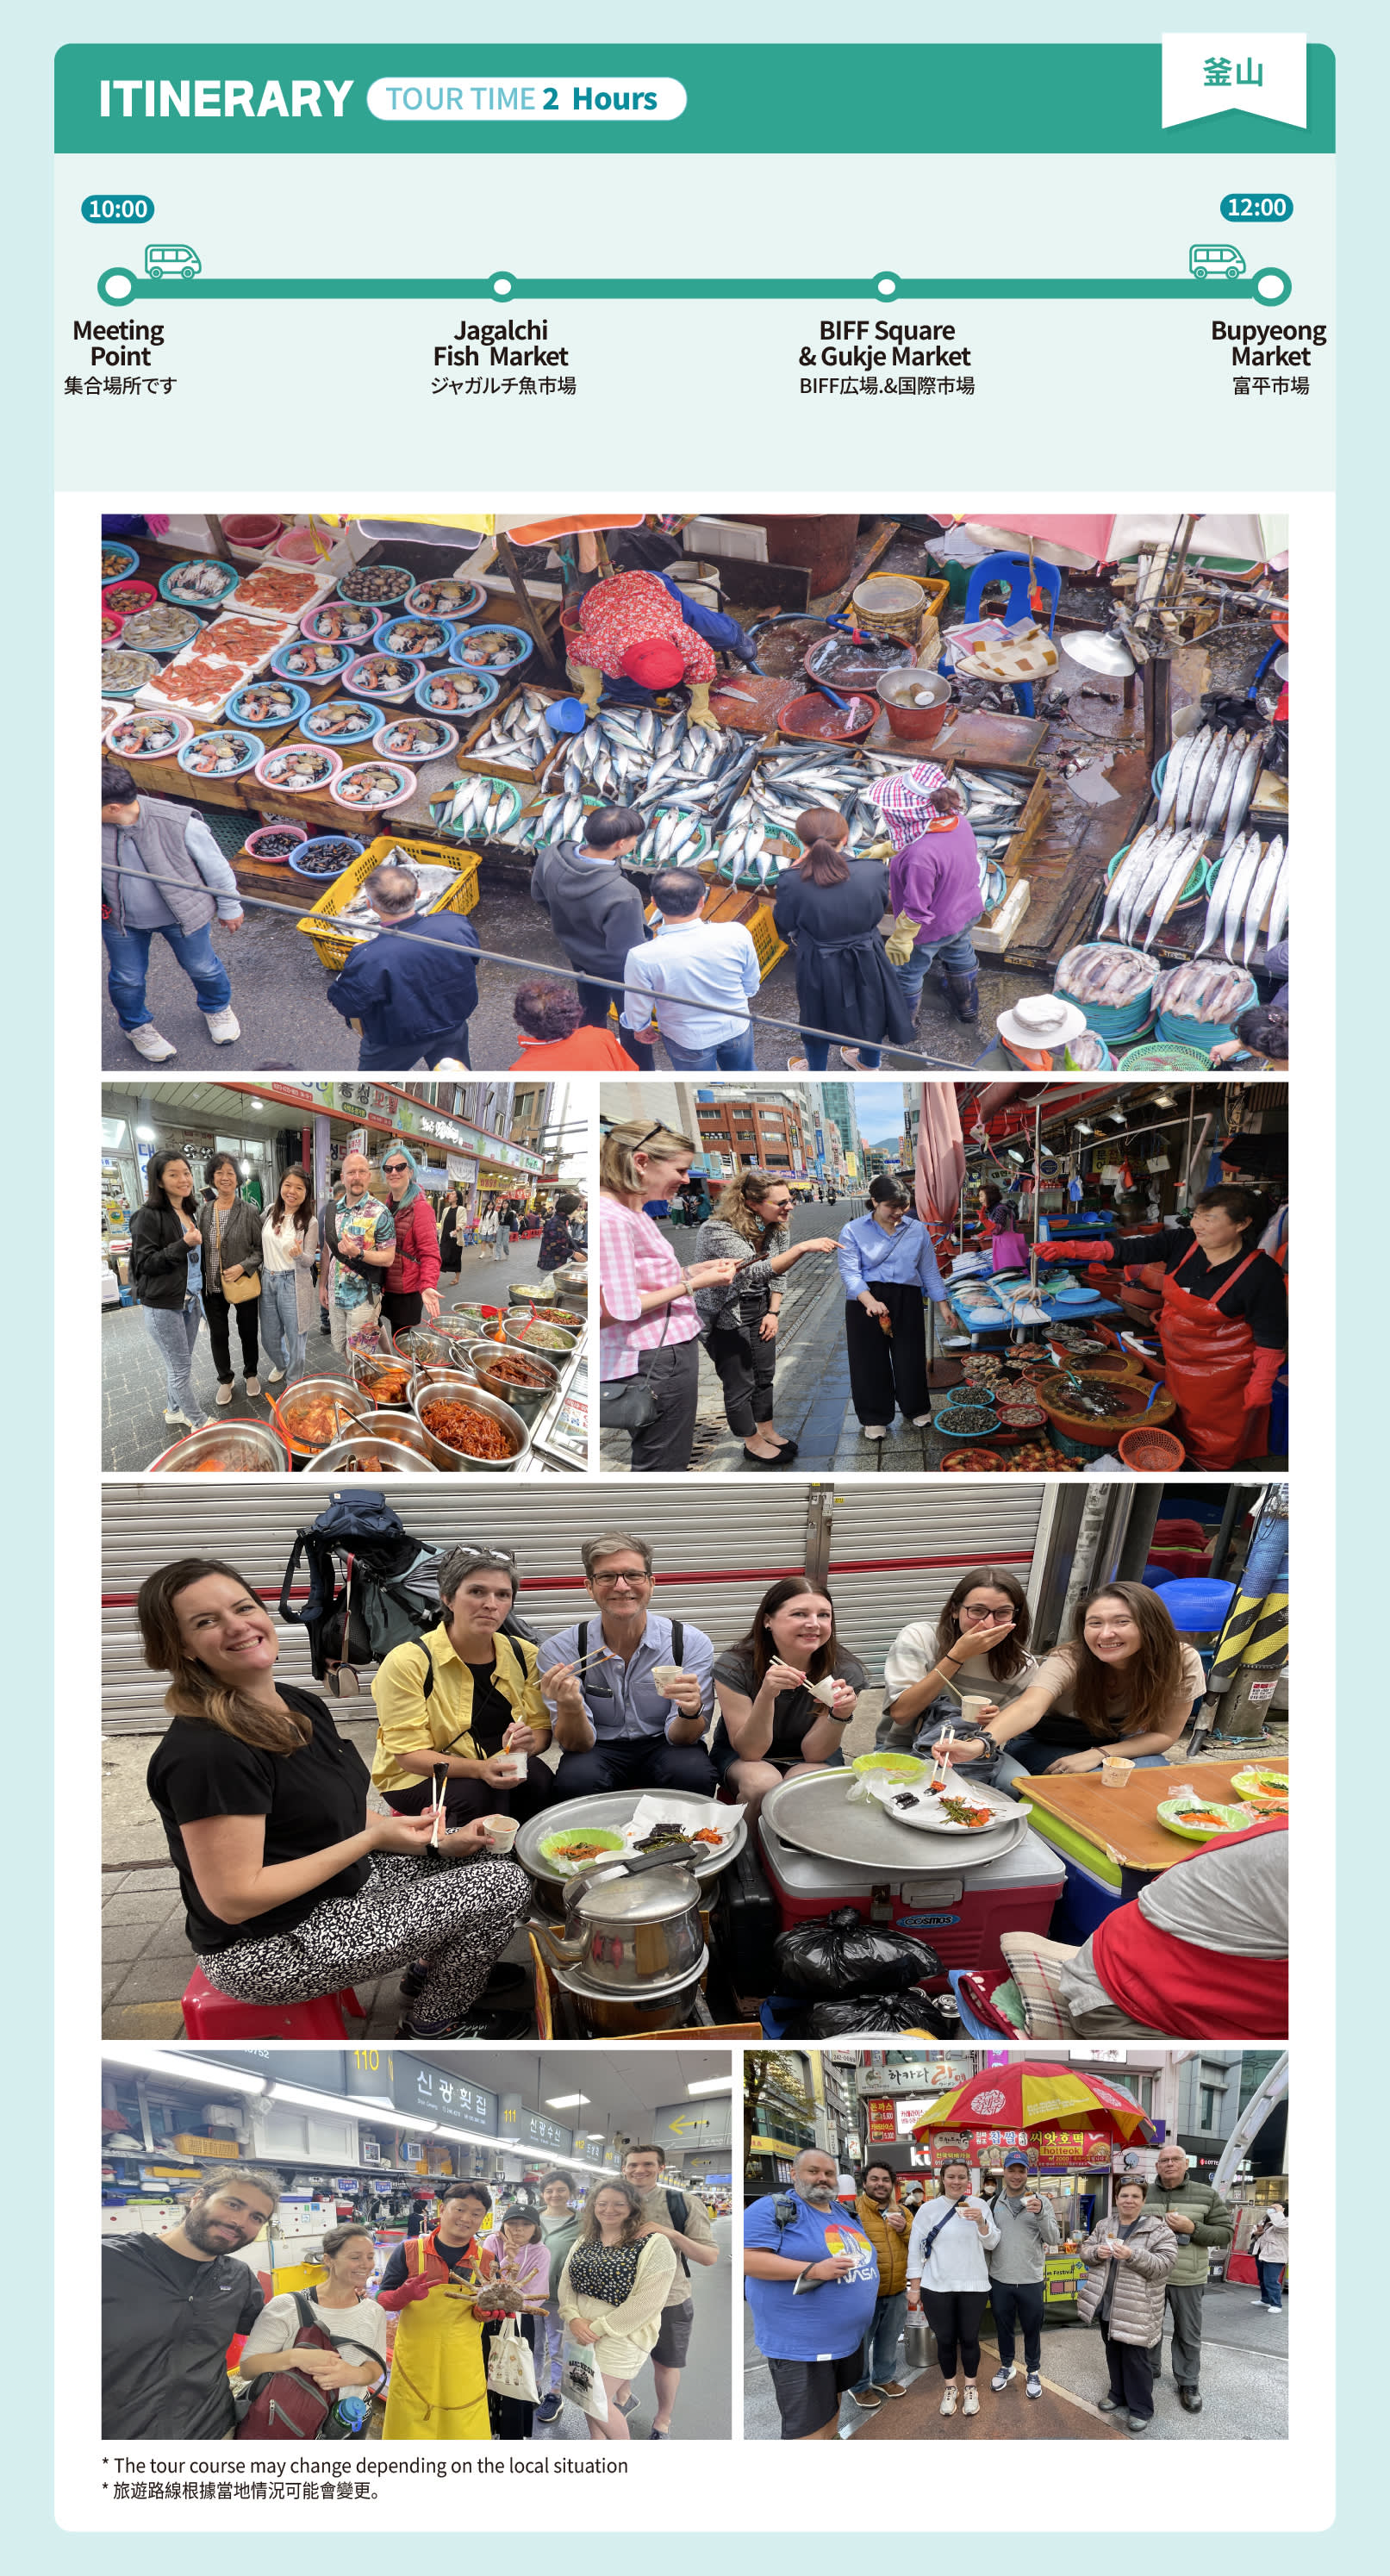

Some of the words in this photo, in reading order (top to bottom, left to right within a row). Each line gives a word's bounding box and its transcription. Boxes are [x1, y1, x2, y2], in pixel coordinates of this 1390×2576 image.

[354, 2050, 379, 2071] 110
[417, 2071, 486, 2116] 신광횟집
[870, 2103, 893, 2111] 돈까스
[504, 2110, 516, 2123] 111
[1030, 2131, 1084, 2146] 씨앗호떡
[837, 2267, 877, 2284] NASA
